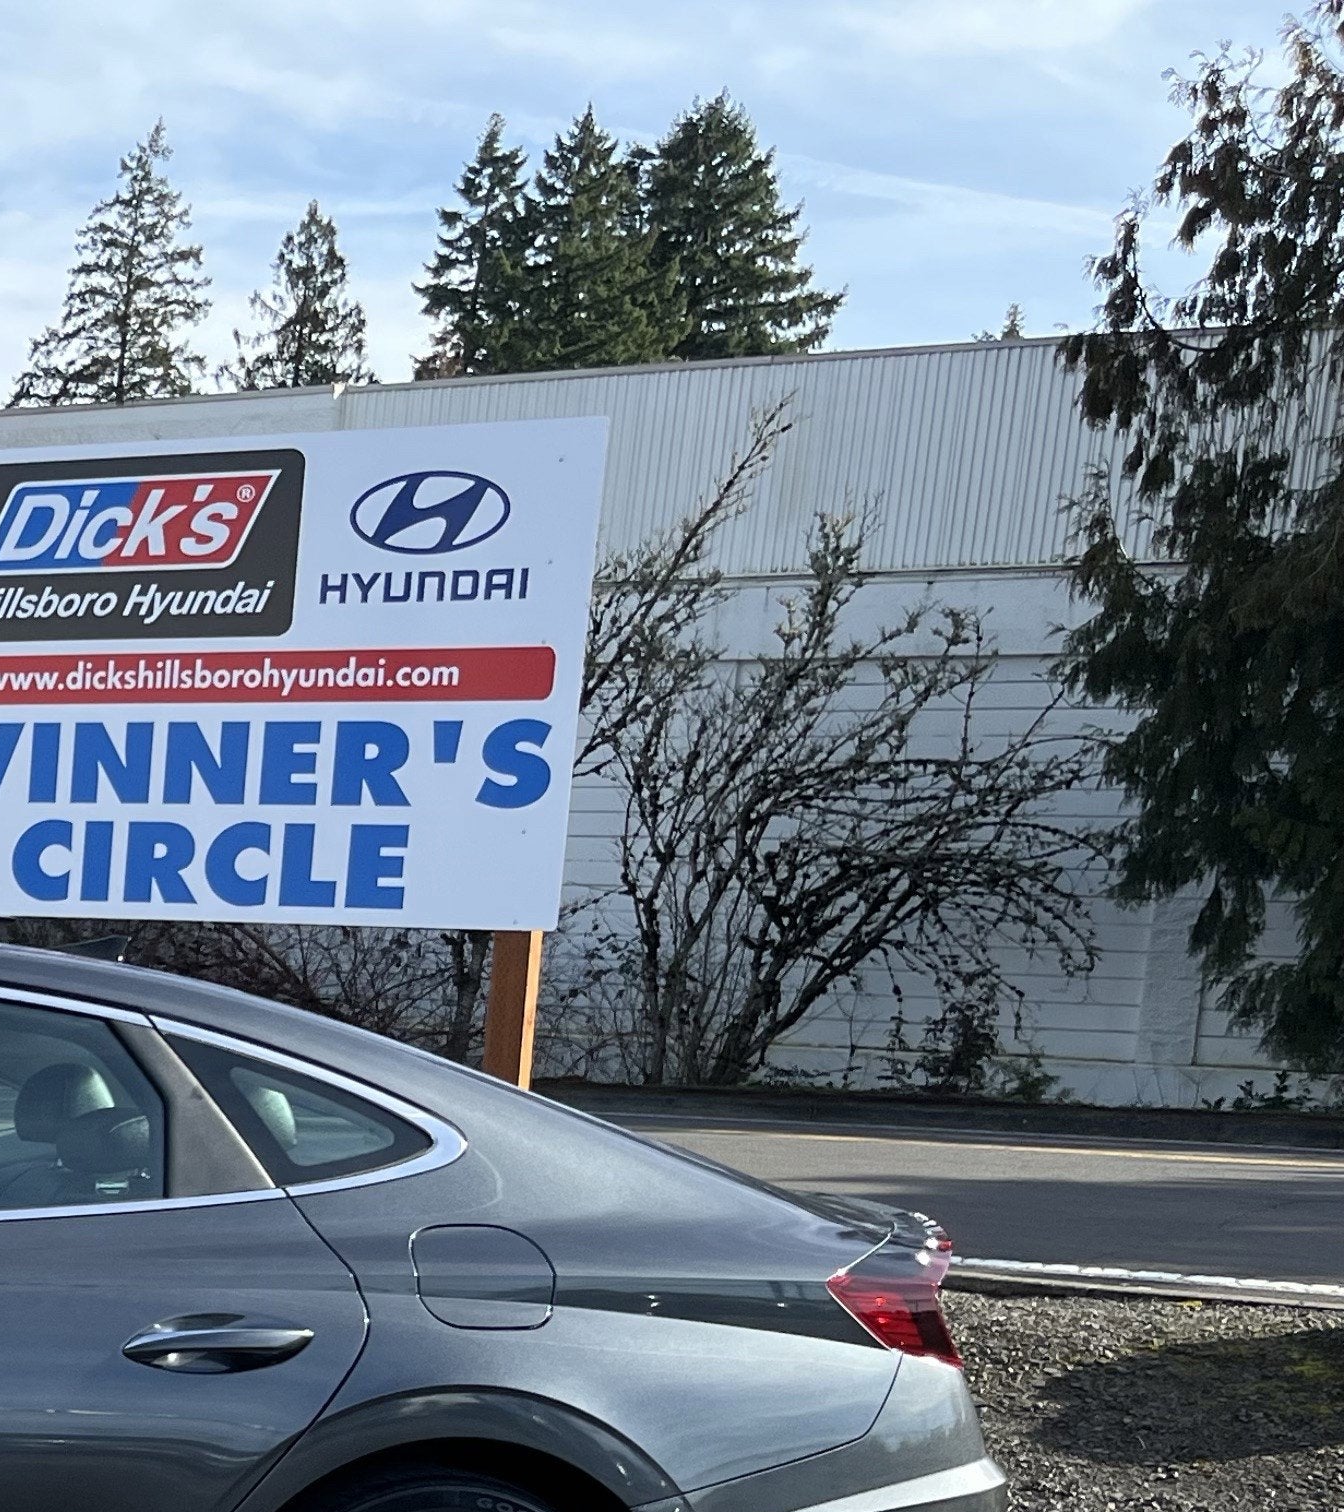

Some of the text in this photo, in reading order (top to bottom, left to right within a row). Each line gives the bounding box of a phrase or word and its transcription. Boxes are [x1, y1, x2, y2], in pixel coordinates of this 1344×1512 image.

[122, 580, 275, 624] Hyundai
[319, 568, 529, 605] HYUNDAI
[11, 818, 412, 909] CIRCLE
